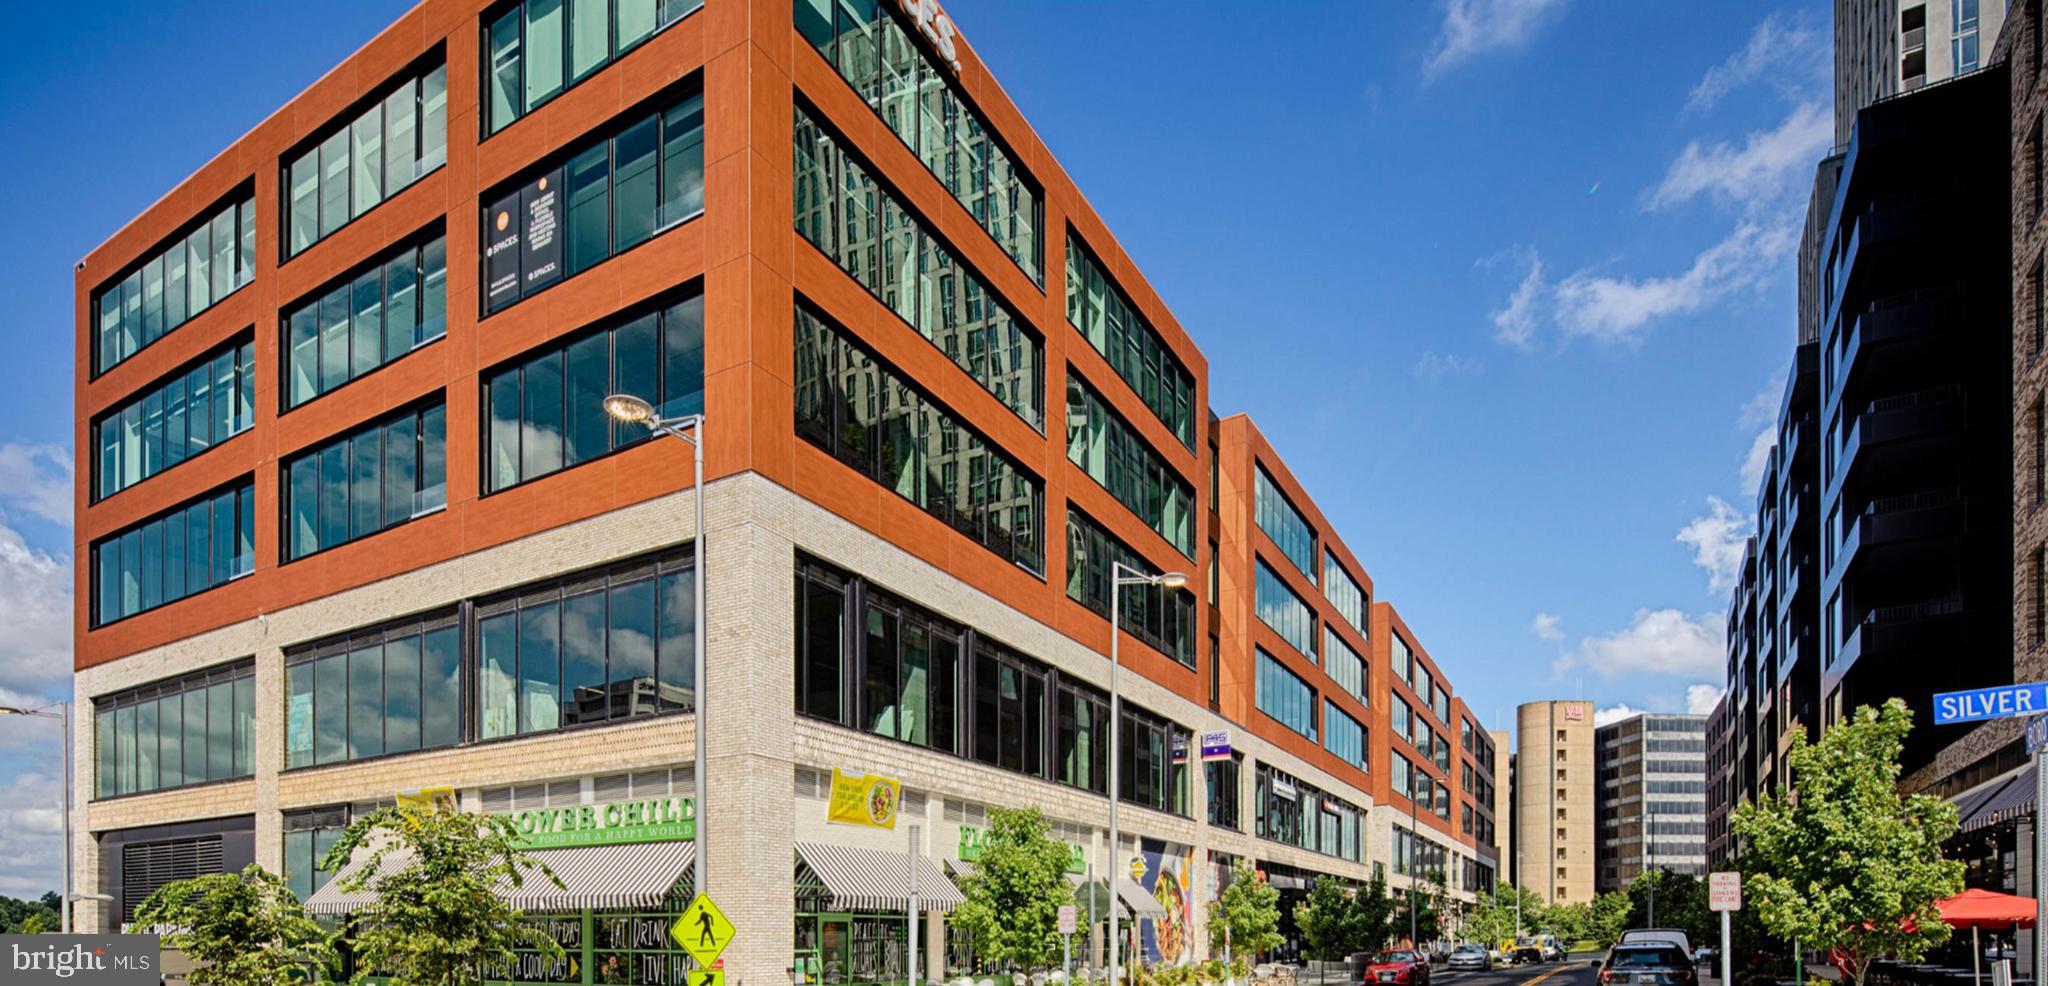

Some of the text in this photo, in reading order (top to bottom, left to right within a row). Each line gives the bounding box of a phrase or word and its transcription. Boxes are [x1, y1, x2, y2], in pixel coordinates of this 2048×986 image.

[1942, 689, 2032, 719] SILVER
[1206, 732, 1227, 743] F45
[491, 797, 696, 834] OWER CHILD
[538, 835, 566, 844] FOOD
[570, 833, 593, 842] FOR
[594, 833, 600, 841] A
[605, 828, 643, 840] HAPPY
[649, 825, 692, 838] WORLD
[610, 918, 669, 949] EAT DRINK
[642, 954, 667, 985] LIVE
